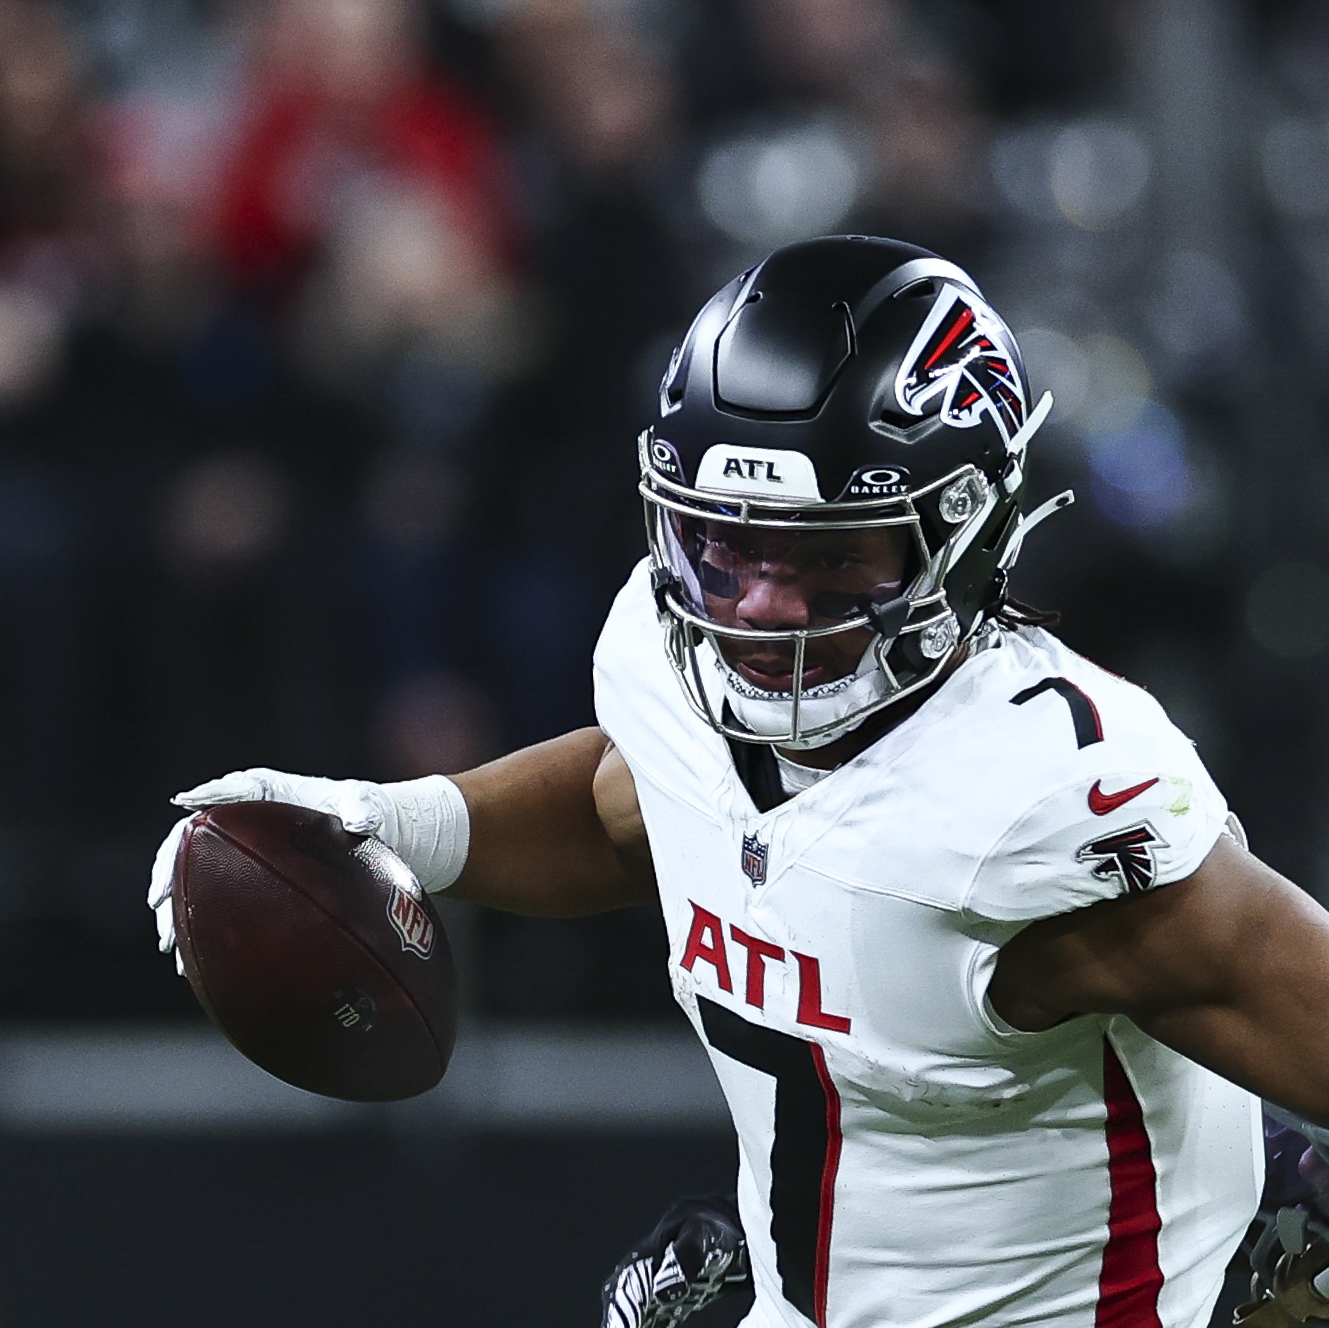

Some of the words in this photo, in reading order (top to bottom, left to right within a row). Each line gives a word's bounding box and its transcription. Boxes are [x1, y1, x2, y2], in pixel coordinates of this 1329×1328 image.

[722, 457, 783, 484] ATL
[850, 484, 910, 496] OAKLEY
[1008, 676, 1104, 751] 7
[744, 853, 764, 879] NFL
[393, 889, 432, 951] NFL
[680, 898, 852, 1035] ATL
